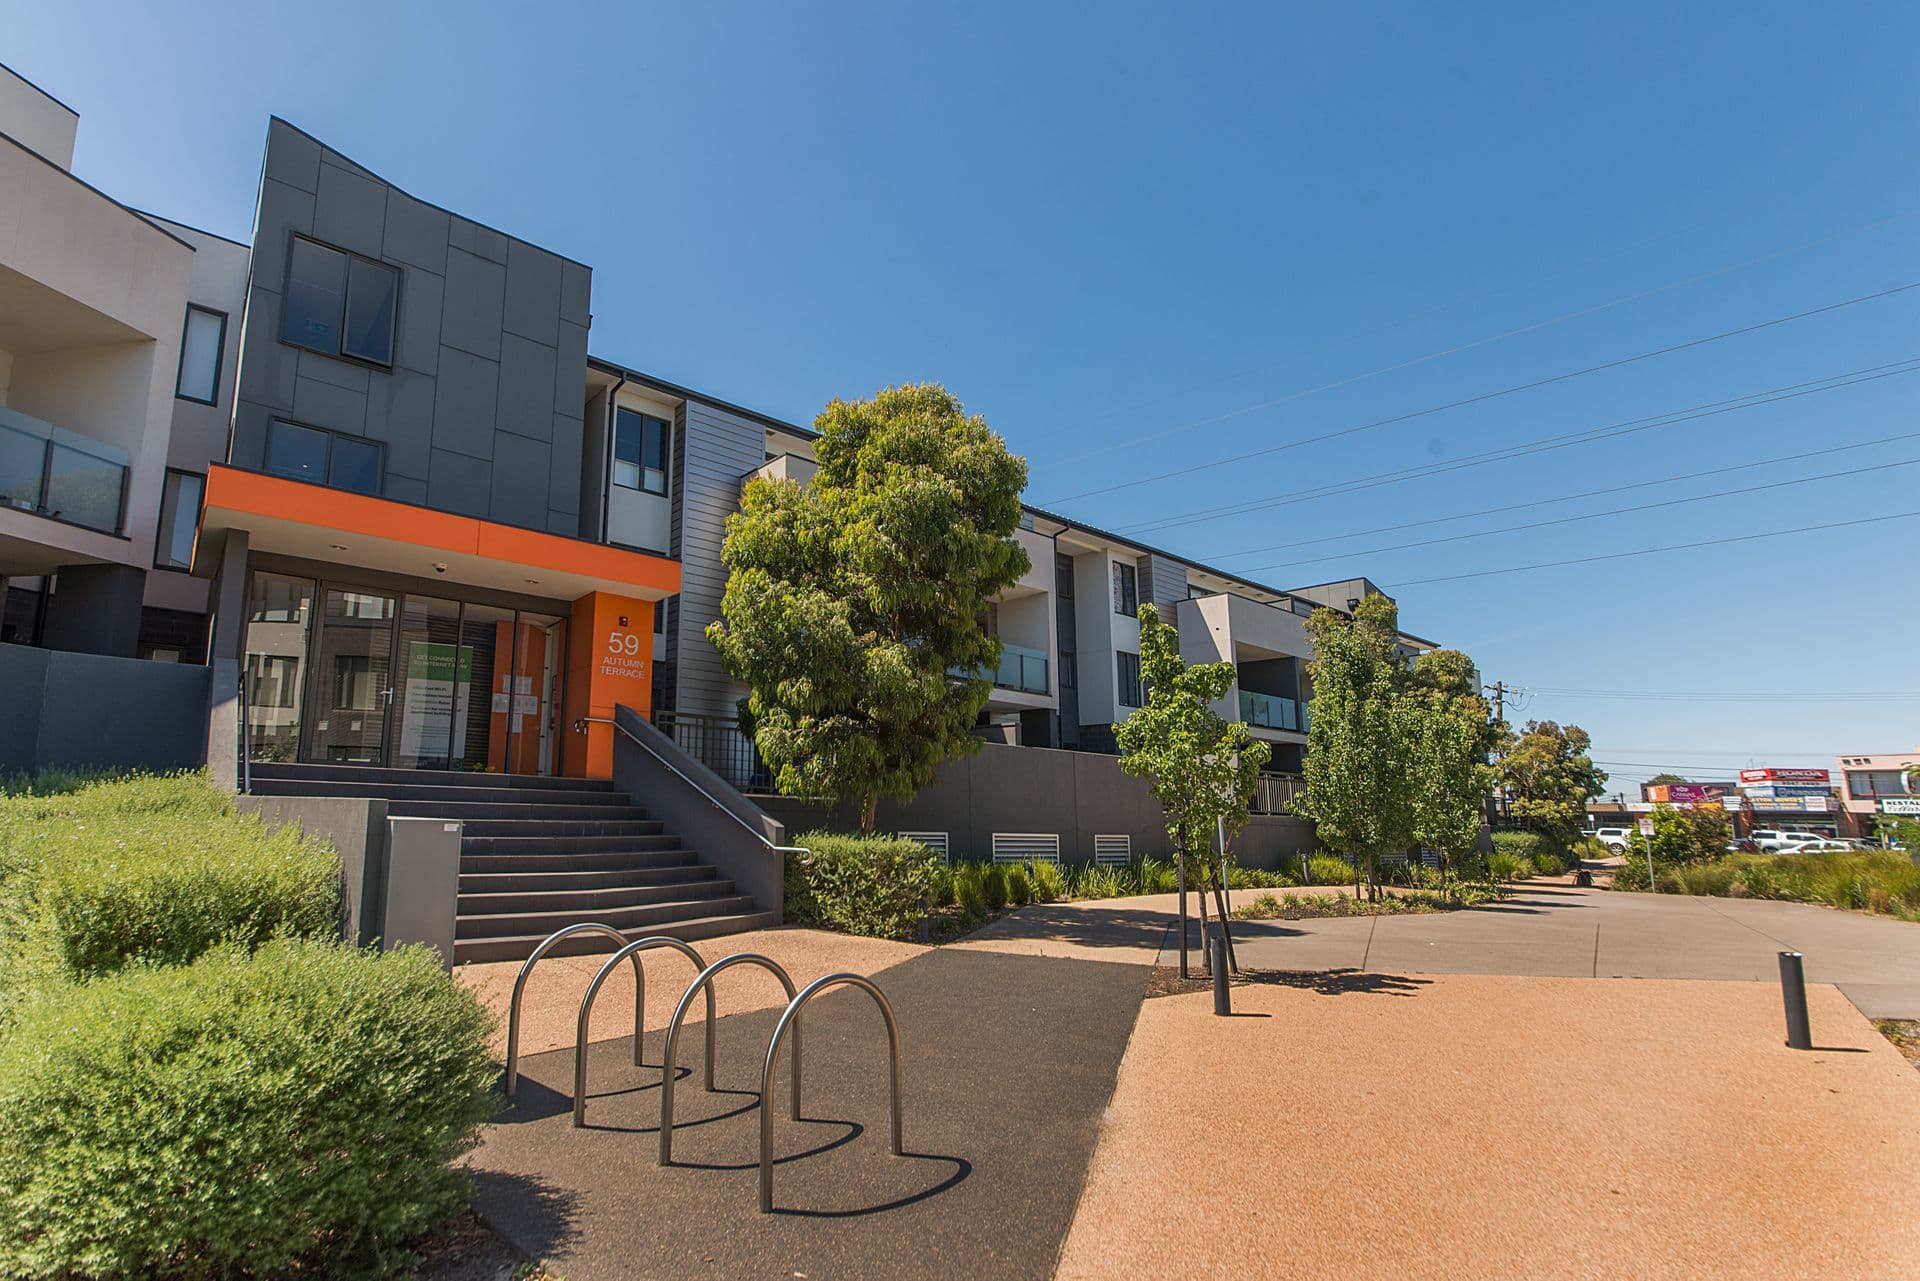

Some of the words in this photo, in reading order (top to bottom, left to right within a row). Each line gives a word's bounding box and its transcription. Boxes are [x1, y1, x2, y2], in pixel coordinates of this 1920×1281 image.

[608, 632, 639, 655] 59
[429, 655, 465, 663] CONNECD
[603, 656, 644, 670] AUTUMN
[600, 666, 645, 679] TERRACE
[1776, 769, 1823, 777] HONDA
